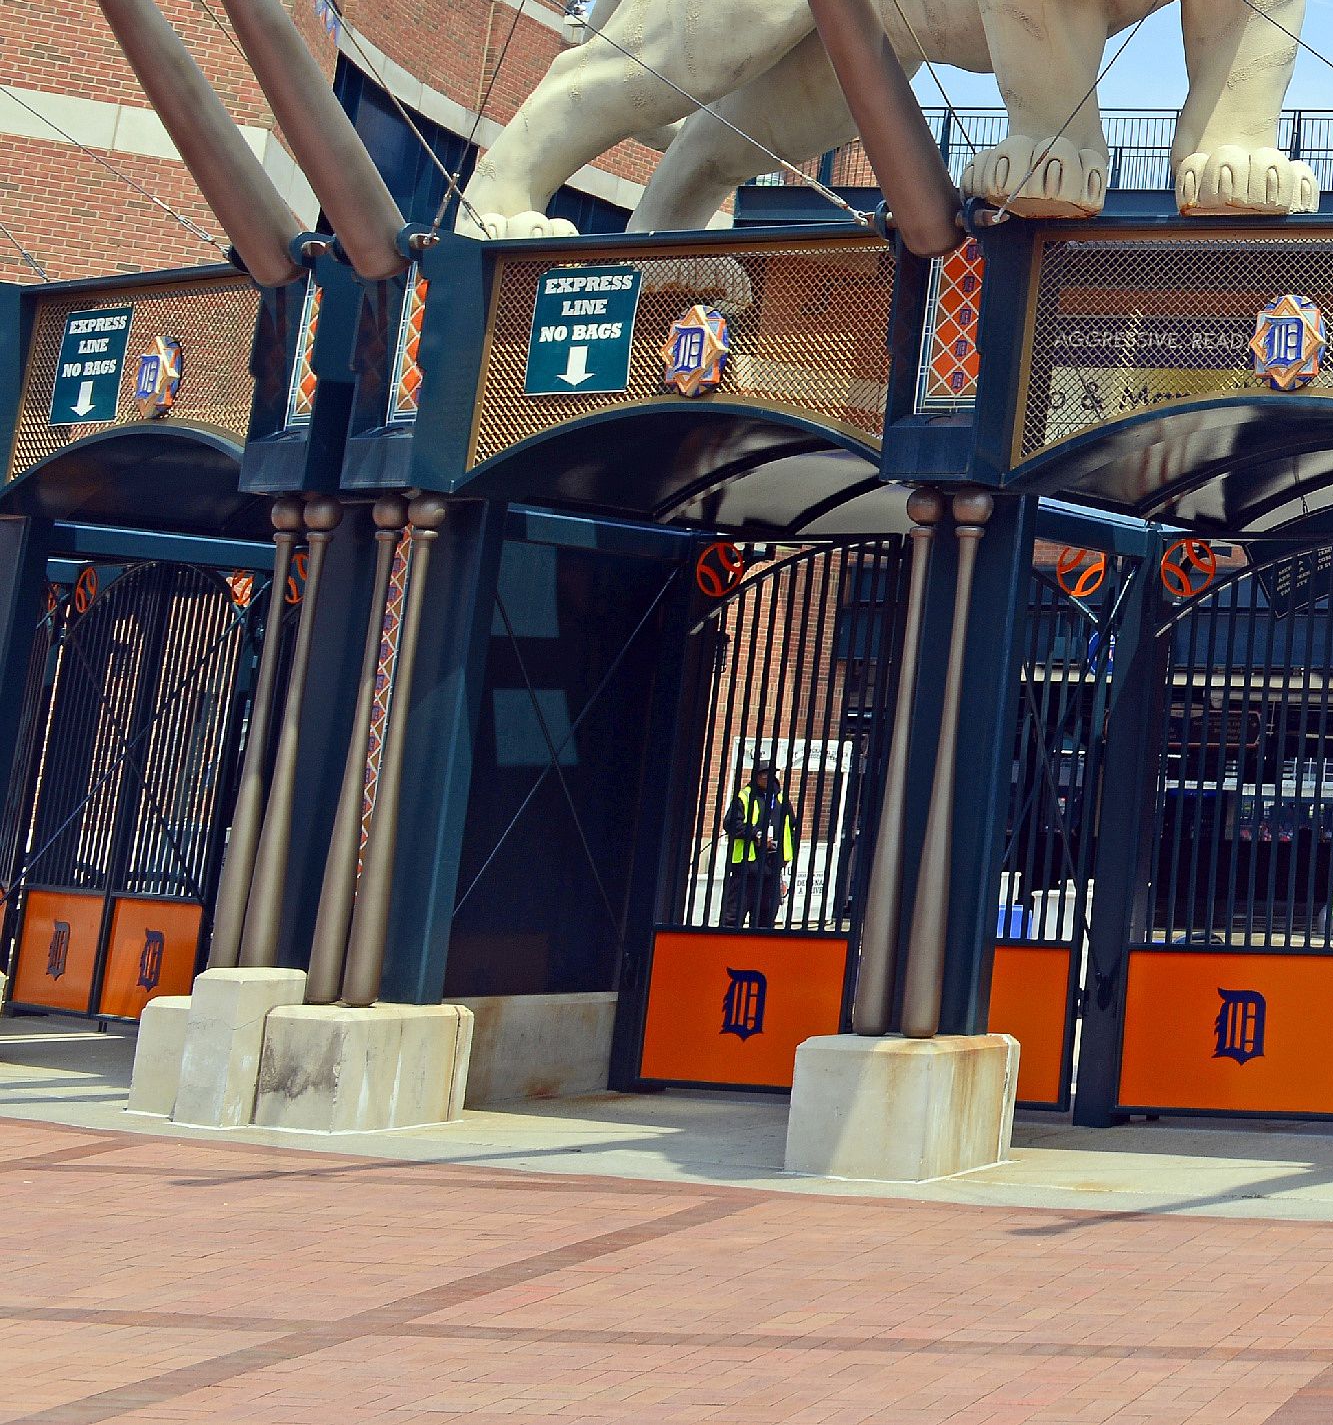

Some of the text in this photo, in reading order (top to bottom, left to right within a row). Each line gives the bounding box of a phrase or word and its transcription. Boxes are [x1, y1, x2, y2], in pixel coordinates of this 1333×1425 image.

[543, 275, 633, 295] EXPRESS
[561, 299, 608, 316] LINE
[68, 315, 128, 335] EXPRESS
[538, 323, 623, 343] NO BAGS
[78, 338, 110, 354] LINE
[62, 360, 117, 378] NO BAGS
